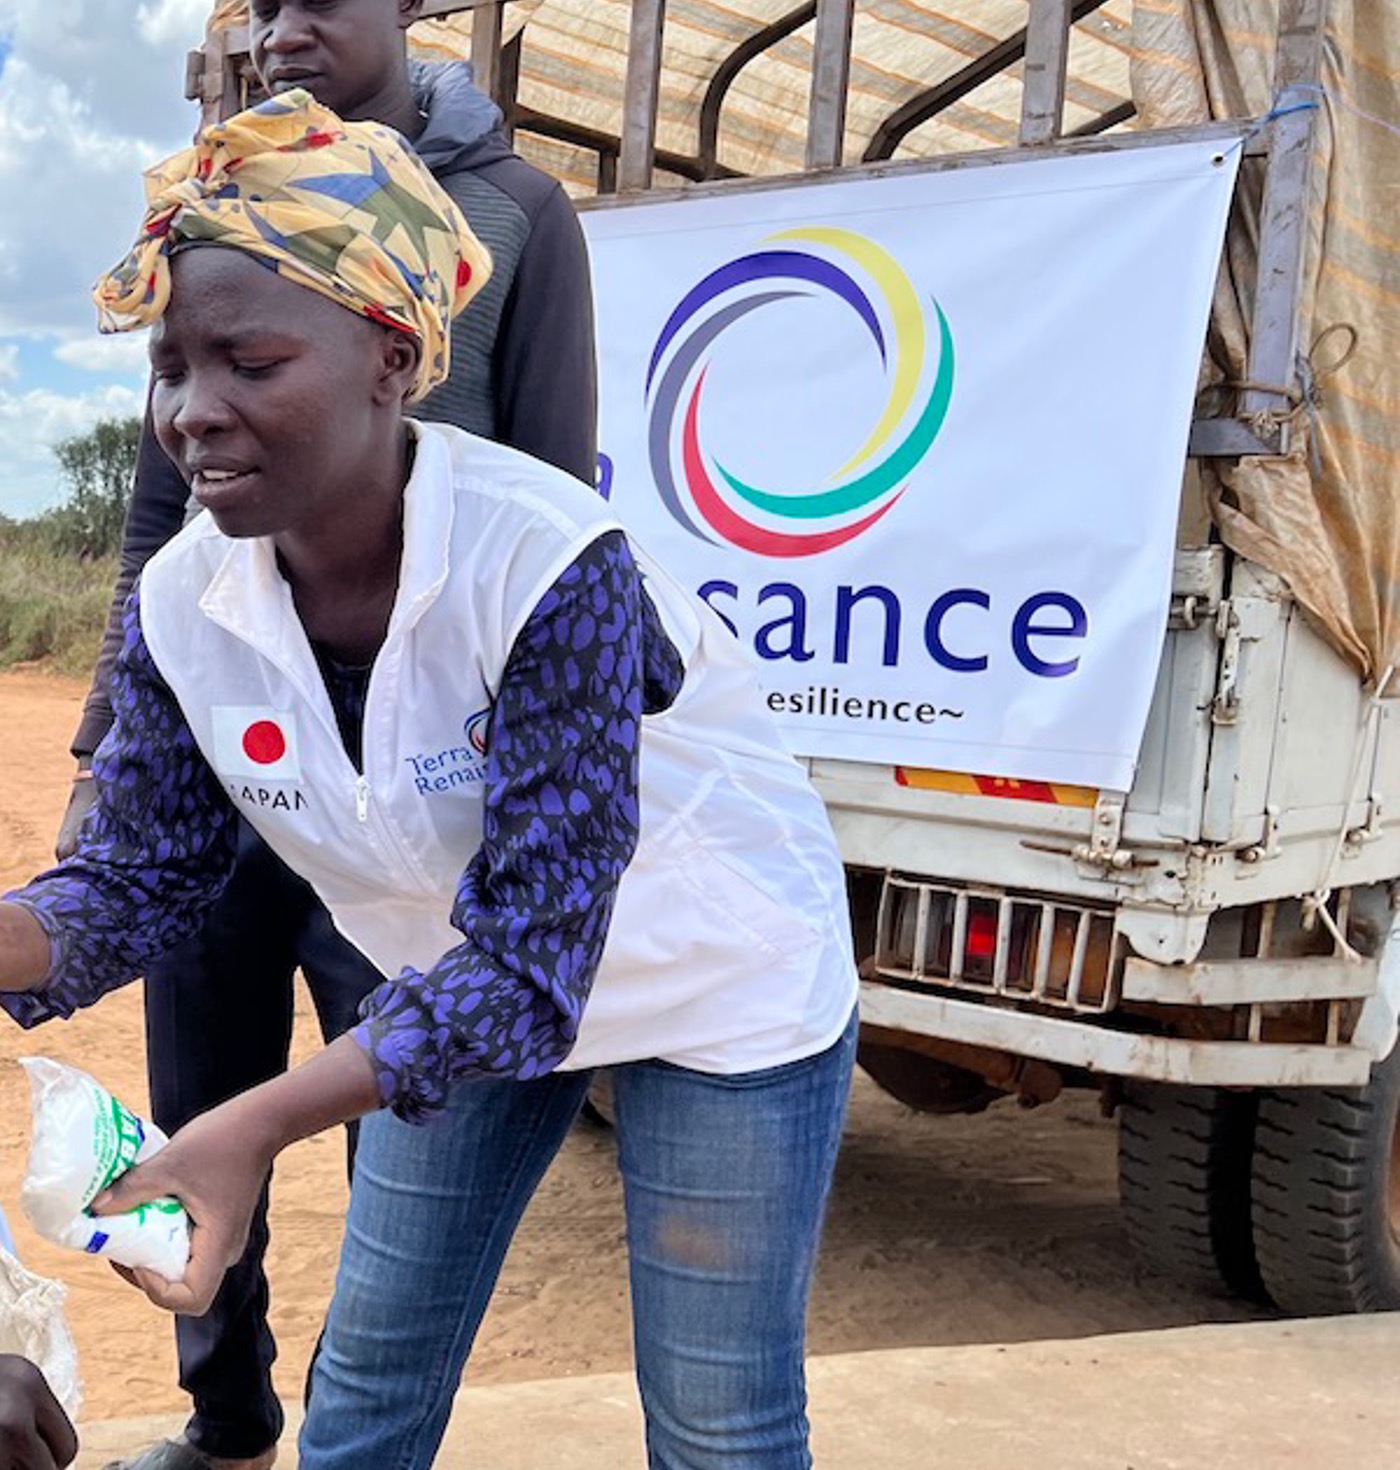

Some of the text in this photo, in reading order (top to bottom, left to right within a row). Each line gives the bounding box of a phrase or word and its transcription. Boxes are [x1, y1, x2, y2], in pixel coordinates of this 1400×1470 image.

[696, 579, 1089, 678] sance
[766, 685, 965, 724] esilience~
[404, 747, 474, 776] Terra
[230, 784, 309, 811] APAN
